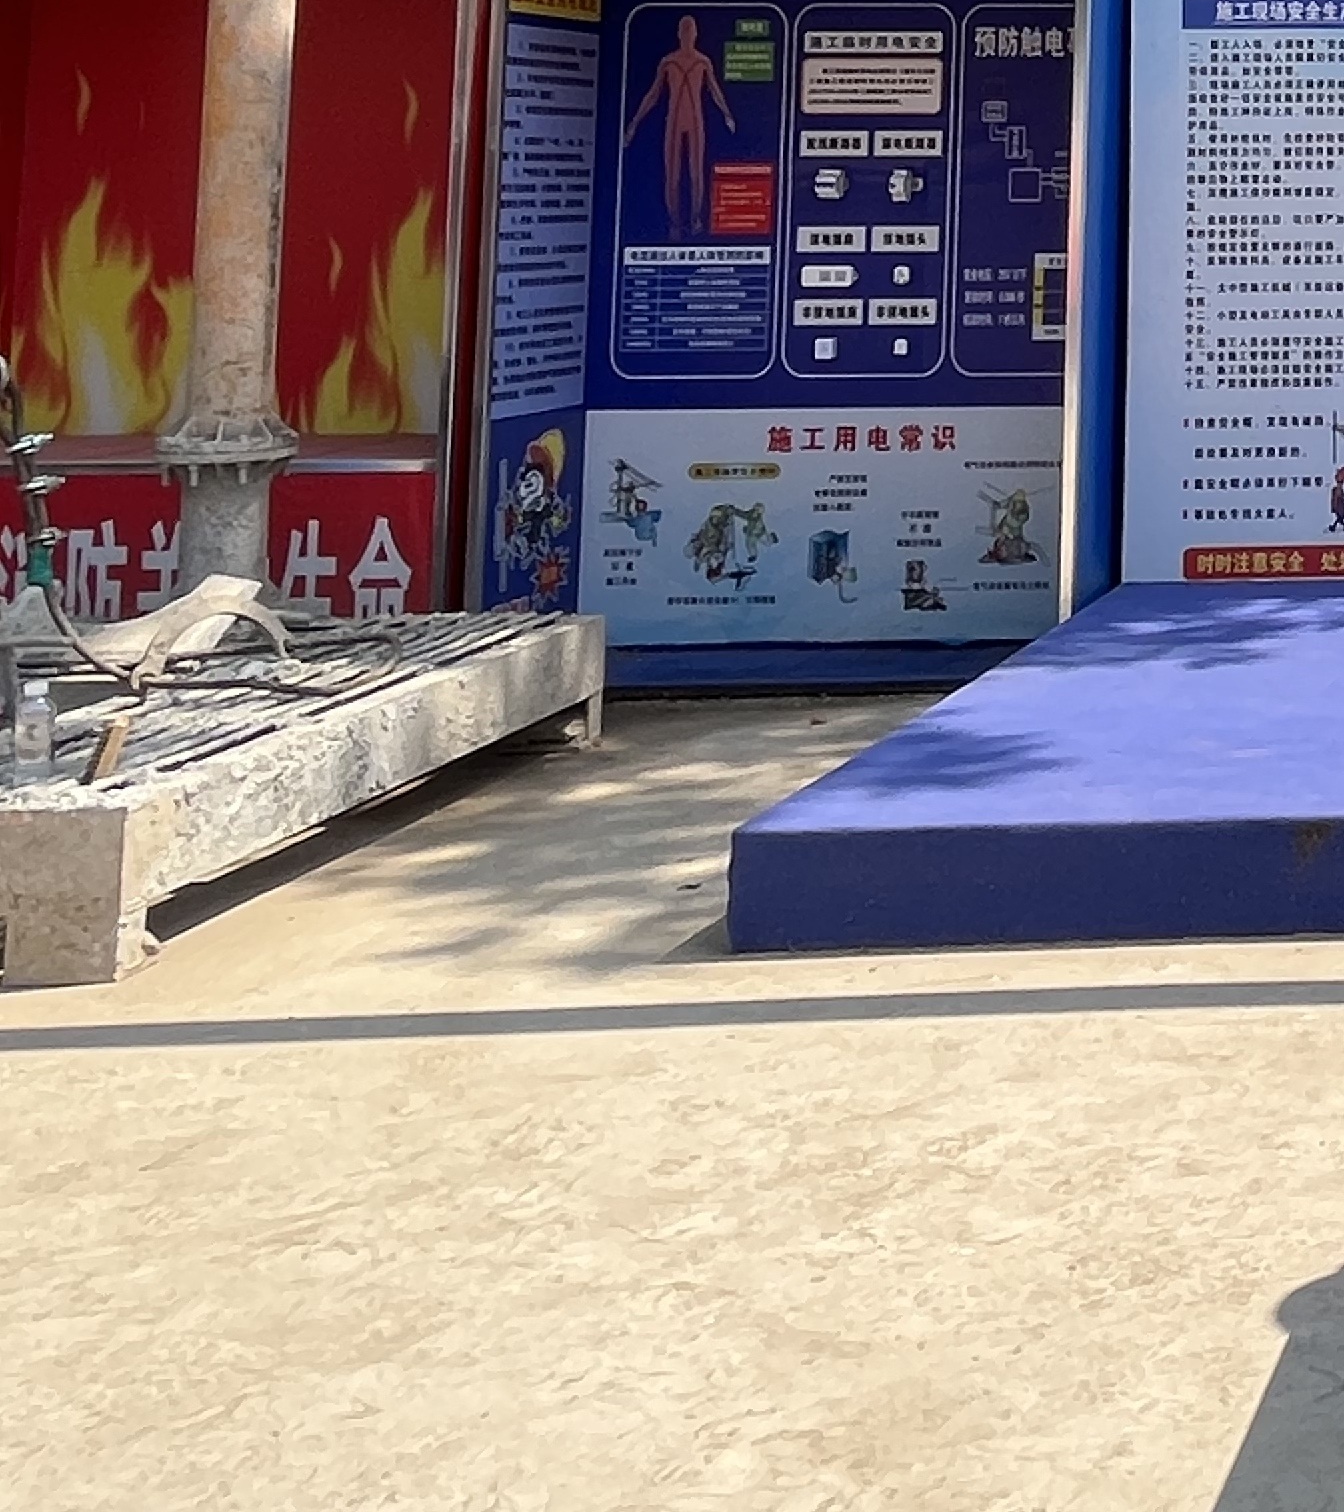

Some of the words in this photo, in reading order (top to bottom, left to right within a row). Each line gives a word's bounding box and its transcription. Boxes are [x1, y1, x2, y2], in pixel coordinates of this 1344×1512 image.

[767, 425, 957, 453] 施工用电常识
[1196, 551, 1304, 574] 时时注意安全
